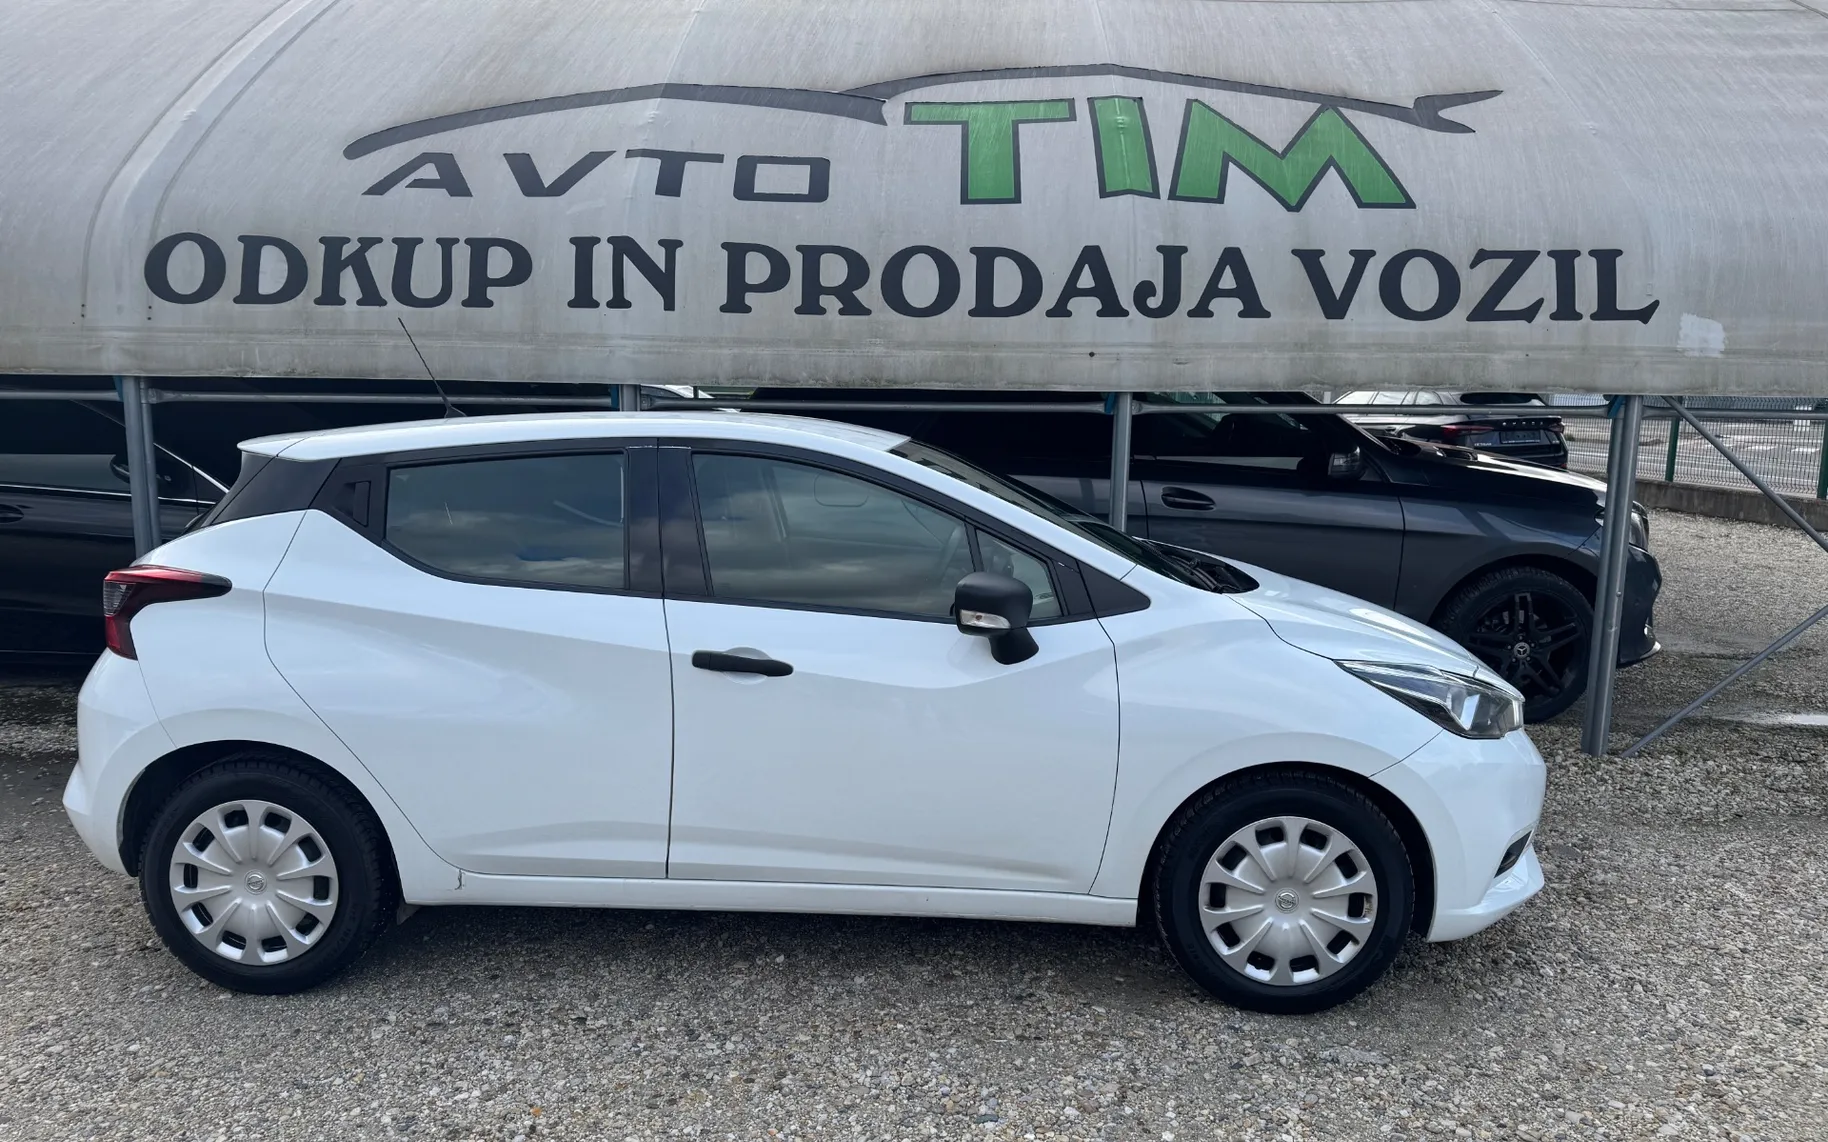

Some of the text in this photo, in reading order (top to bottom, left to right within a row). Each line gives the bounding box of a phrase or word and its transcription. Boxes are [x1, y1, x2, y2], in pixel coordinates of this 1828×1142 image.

[361, 95, 1417, 213] AVTO TIM
[143, 231, 1661, 325] ODKUP IN PRODAJA VOZIL
